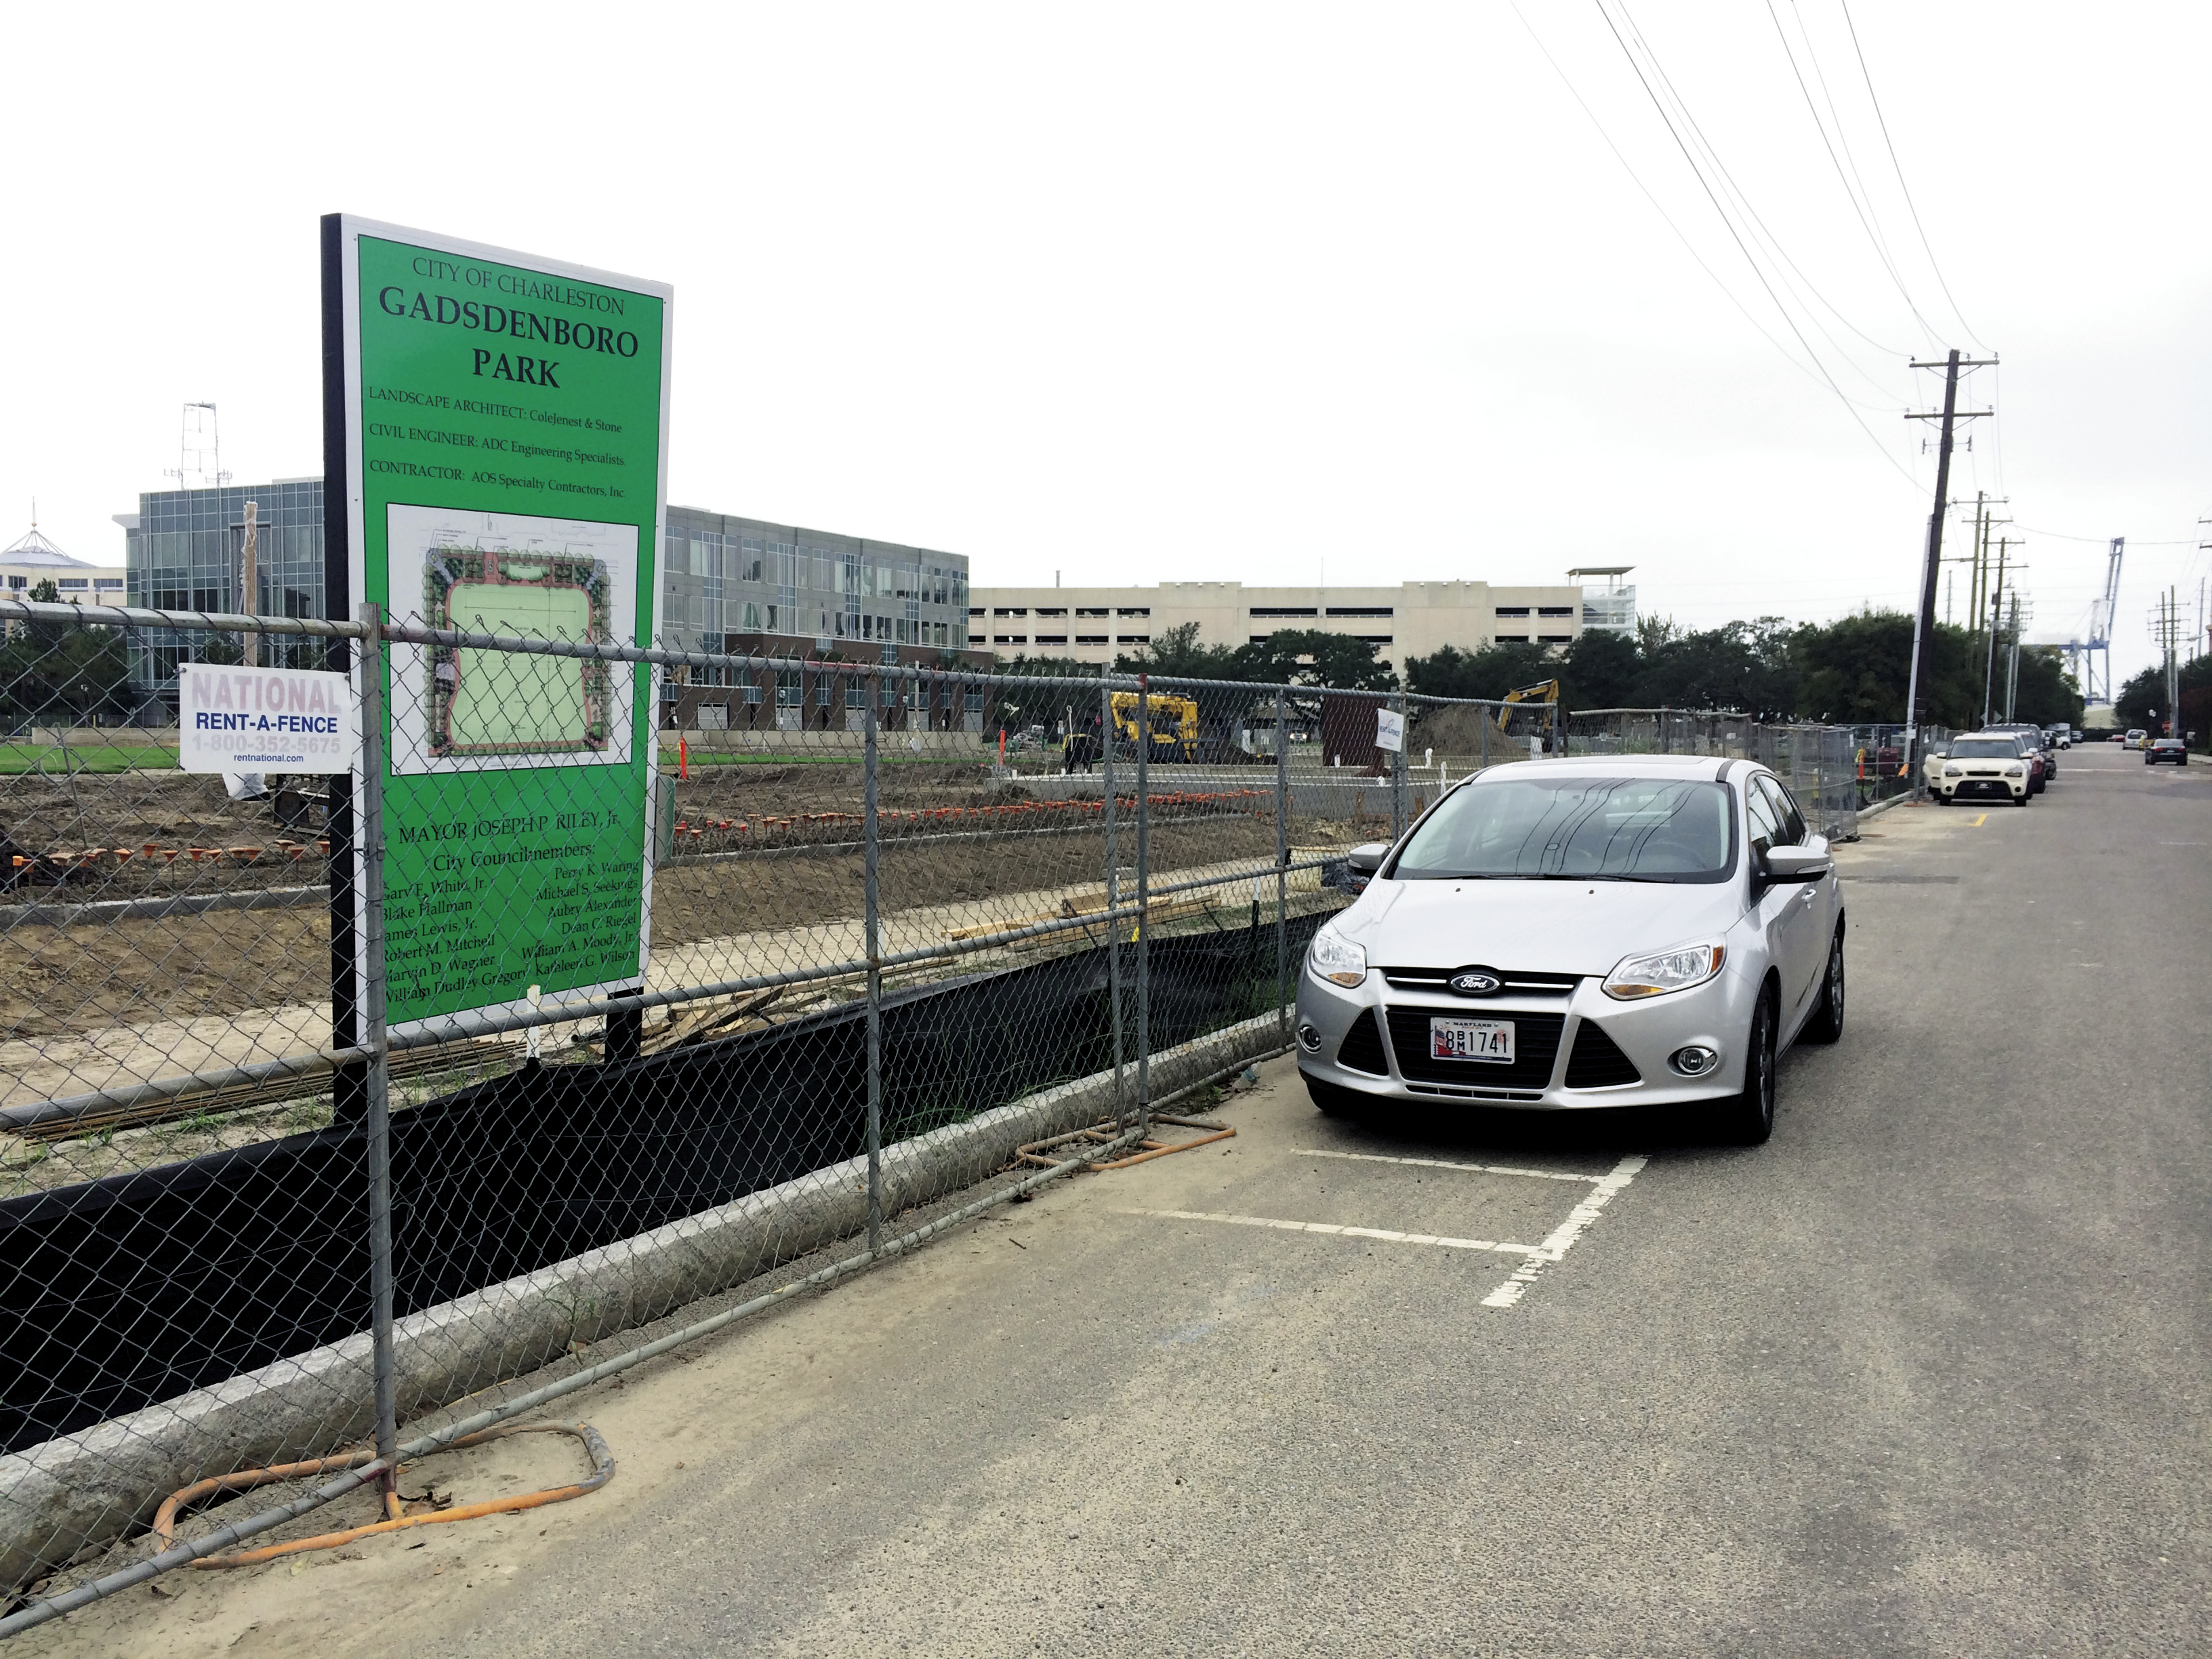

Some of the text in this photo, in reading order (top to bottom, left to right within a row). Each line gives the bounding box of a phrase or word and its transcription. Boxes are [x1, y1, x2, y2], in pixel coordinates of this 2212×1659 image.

[413, 257, 624, 316] CITY OF CHARLESTON
[379, 286, 638, 357] GADSDENBORO
[472, 348, 560, 388] PARK
[369, 386, 450, 409] LANDSCAPE
[453, 398, 527, 419] ARCHITECT:
[585, 417, 593, 429] &
[595, 419, 622, 433] Stone
[369, 424, 405, 439] CIVIL
[409, 428, 478, 448] ENGINEER:
[481, 438, 508, 451] ADC
[512, 441, 573, 463] Engineering
[370, 459, 465, 480] CONTRACTOR:
[472, 471, 497, 485] AOS
[499, 474, 545, 493] Specialty
[548, 479, 607, 497] Contractors,
[192, 672, 342, 714] NATIONAL
[197, 712, 337, 733] RENT-A-FENCE
[192, 733, 341, 754] 1-800-352-5675
[234, 753, 304, 762] rentnational.com
[398, 822, 467, 844] MAYOR
[472, 815, 533, 841] JOSEPH
[433, 842, 595, 875] City Councilmembers:
[555, 867, 584, 882] Perry
[602, 861, 639, 874] Waring
[474, 876, 487, 893] Jr.
[536, 882, 578, 901] Michael
[594, 879, 638, 894] Seekings
[419, 900, 472, 916] Hallman
[585, 895, 638, 913] Alexander
[562, 920, 589, 935] Dean
[605, 912, 636, 929] Riegel
[384, 929, 417, 942] ames
[447, 933, 495, 953] Mitchell
[449, 955, 495, 973] Wagner
[434, 976, 478, 996] Dudley
[482, 970, 527, 986] Gregory
[1460, 977, 1488, 989] Ford
